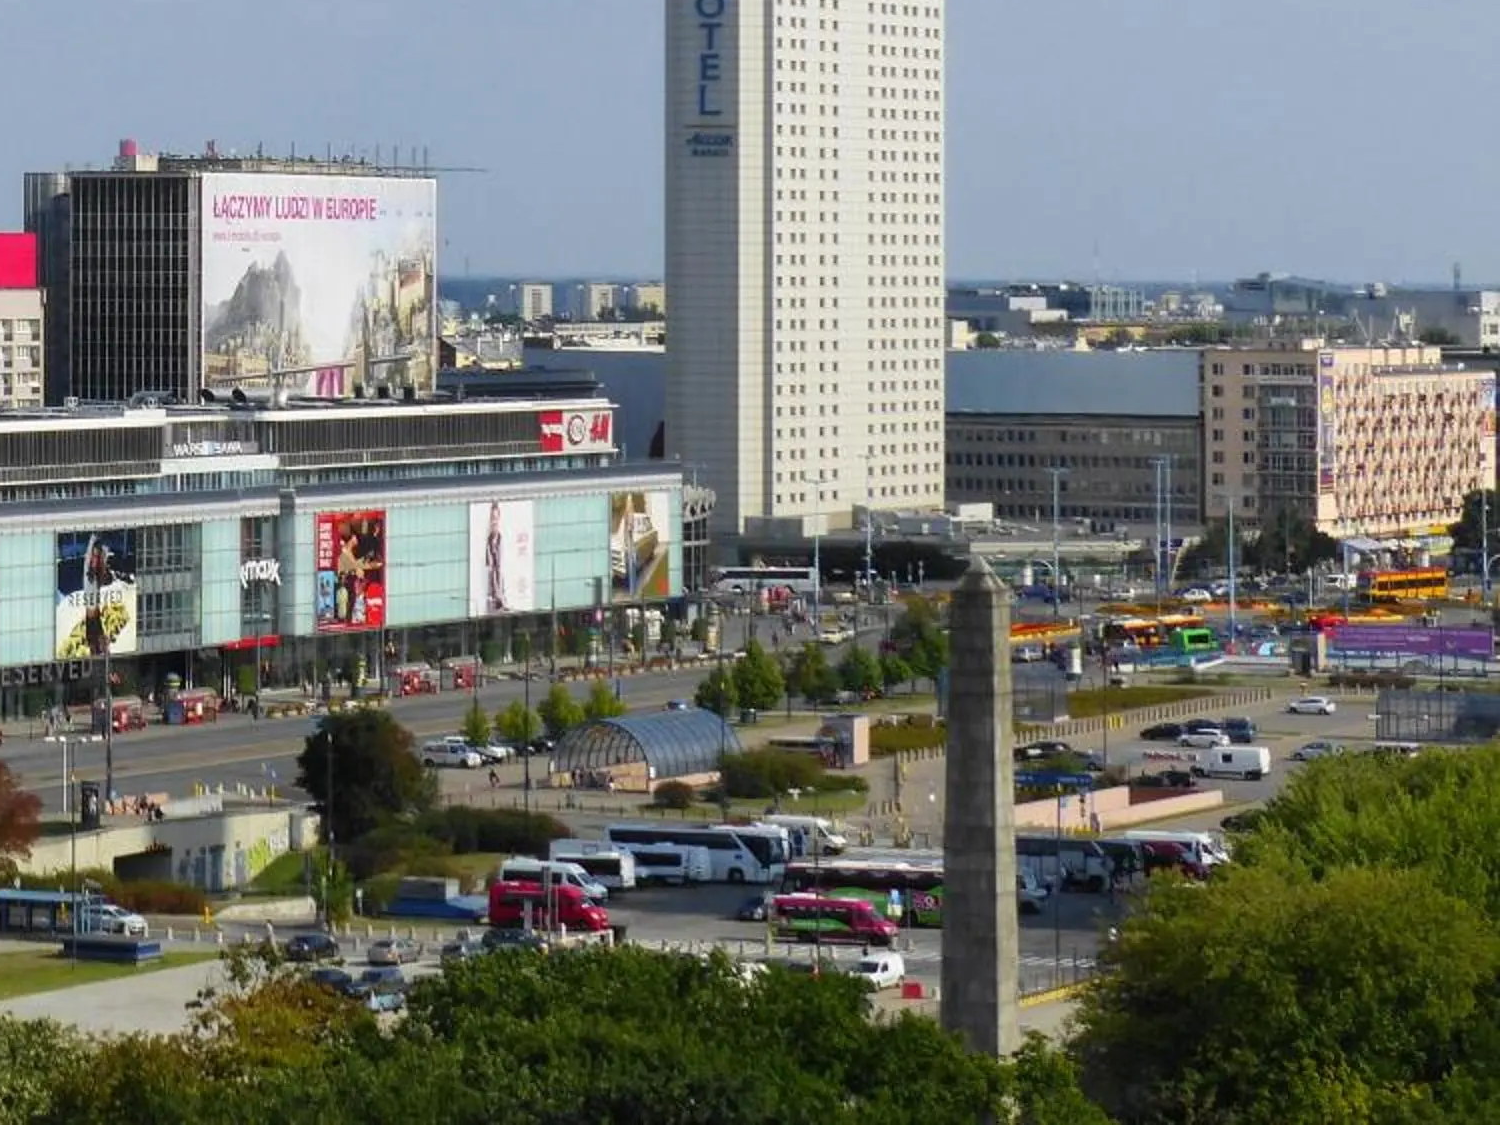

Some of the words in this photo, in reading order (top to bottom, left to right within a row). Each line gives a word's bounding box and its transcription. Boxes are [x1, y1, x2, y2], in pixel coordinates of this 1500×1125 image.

[275, 196, 309, 219] LUDZI
[311, 197, 324, 219] W
[326, 197, 377, 221] EUROPIE
[68, 590, 123, 606] RESERVED
